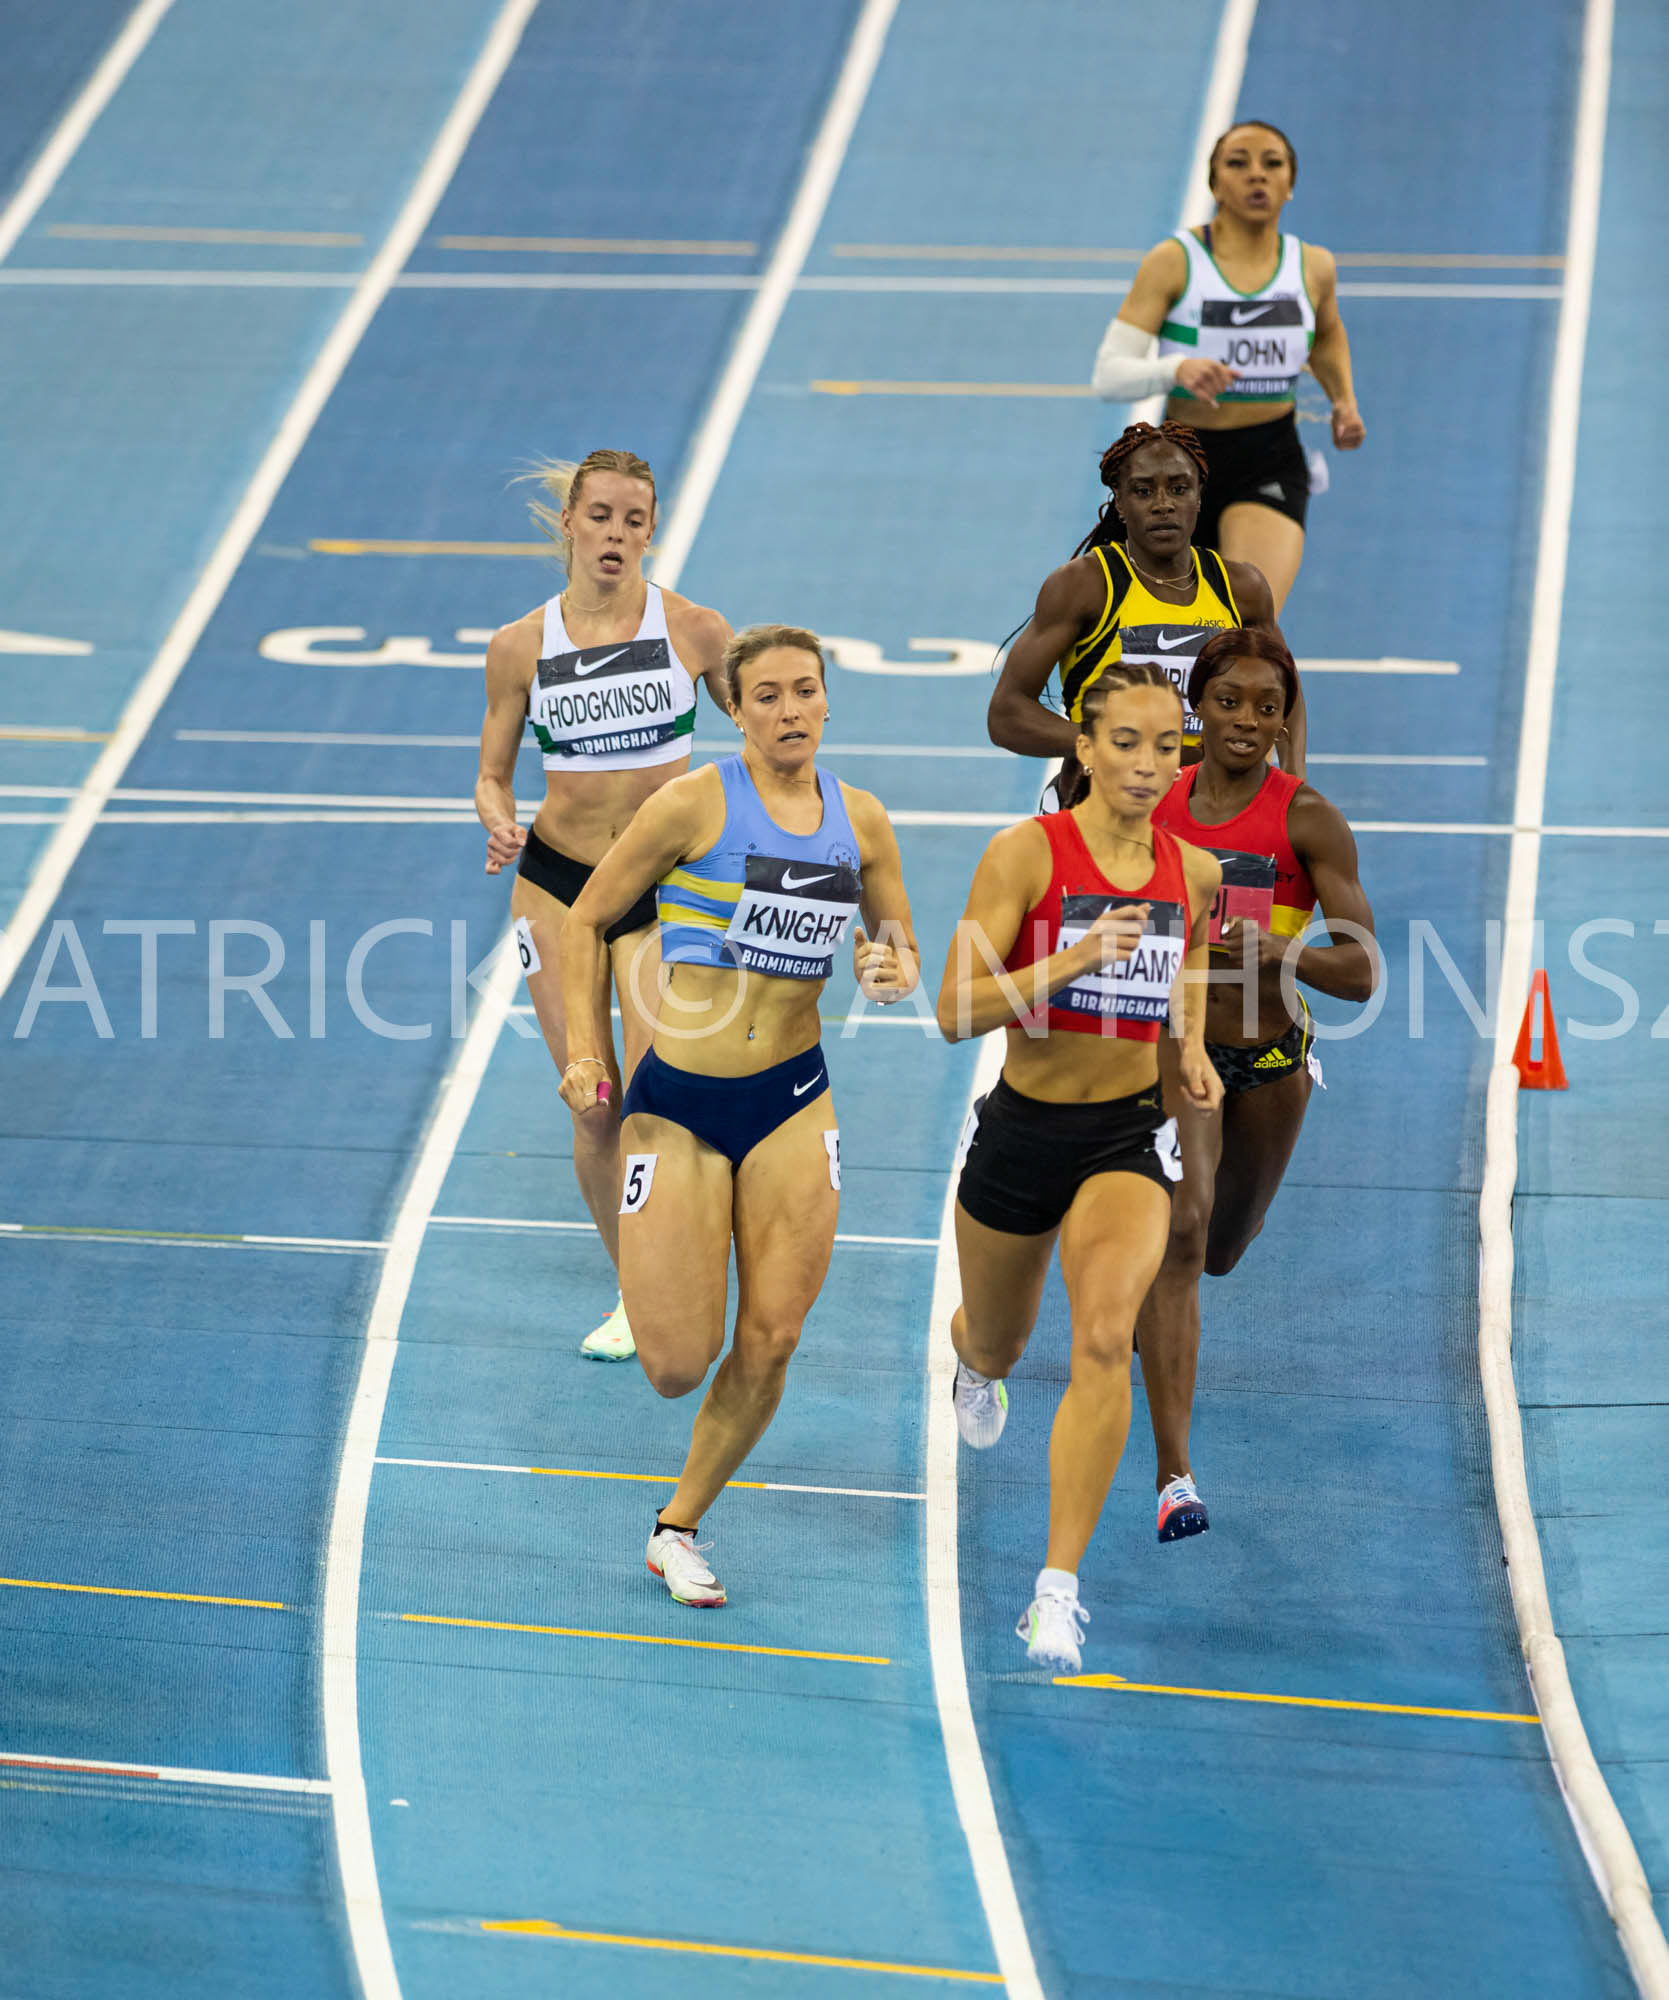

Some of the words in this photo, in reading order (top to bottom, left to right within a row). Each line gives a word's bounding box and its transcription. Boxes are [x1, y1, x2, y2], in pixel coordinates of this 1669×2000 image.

[1220, 339, 1287, 366] JOHN
[547, 680, 672, 730] HODGKINSON
[571, 729, 659, 755] BIRMINGHAM
[743, 903, 848, 946] KNIGHT
[741, 949, 826, 976] BIRMINGHAM
[1063, 941, 1180, 985] LIAMS
[1070, 991, 1169, 1018] BIRMINGHAM
[1253, 1057, 1293, 1069] adidas
[626, 1163, 646, 1206] 5
